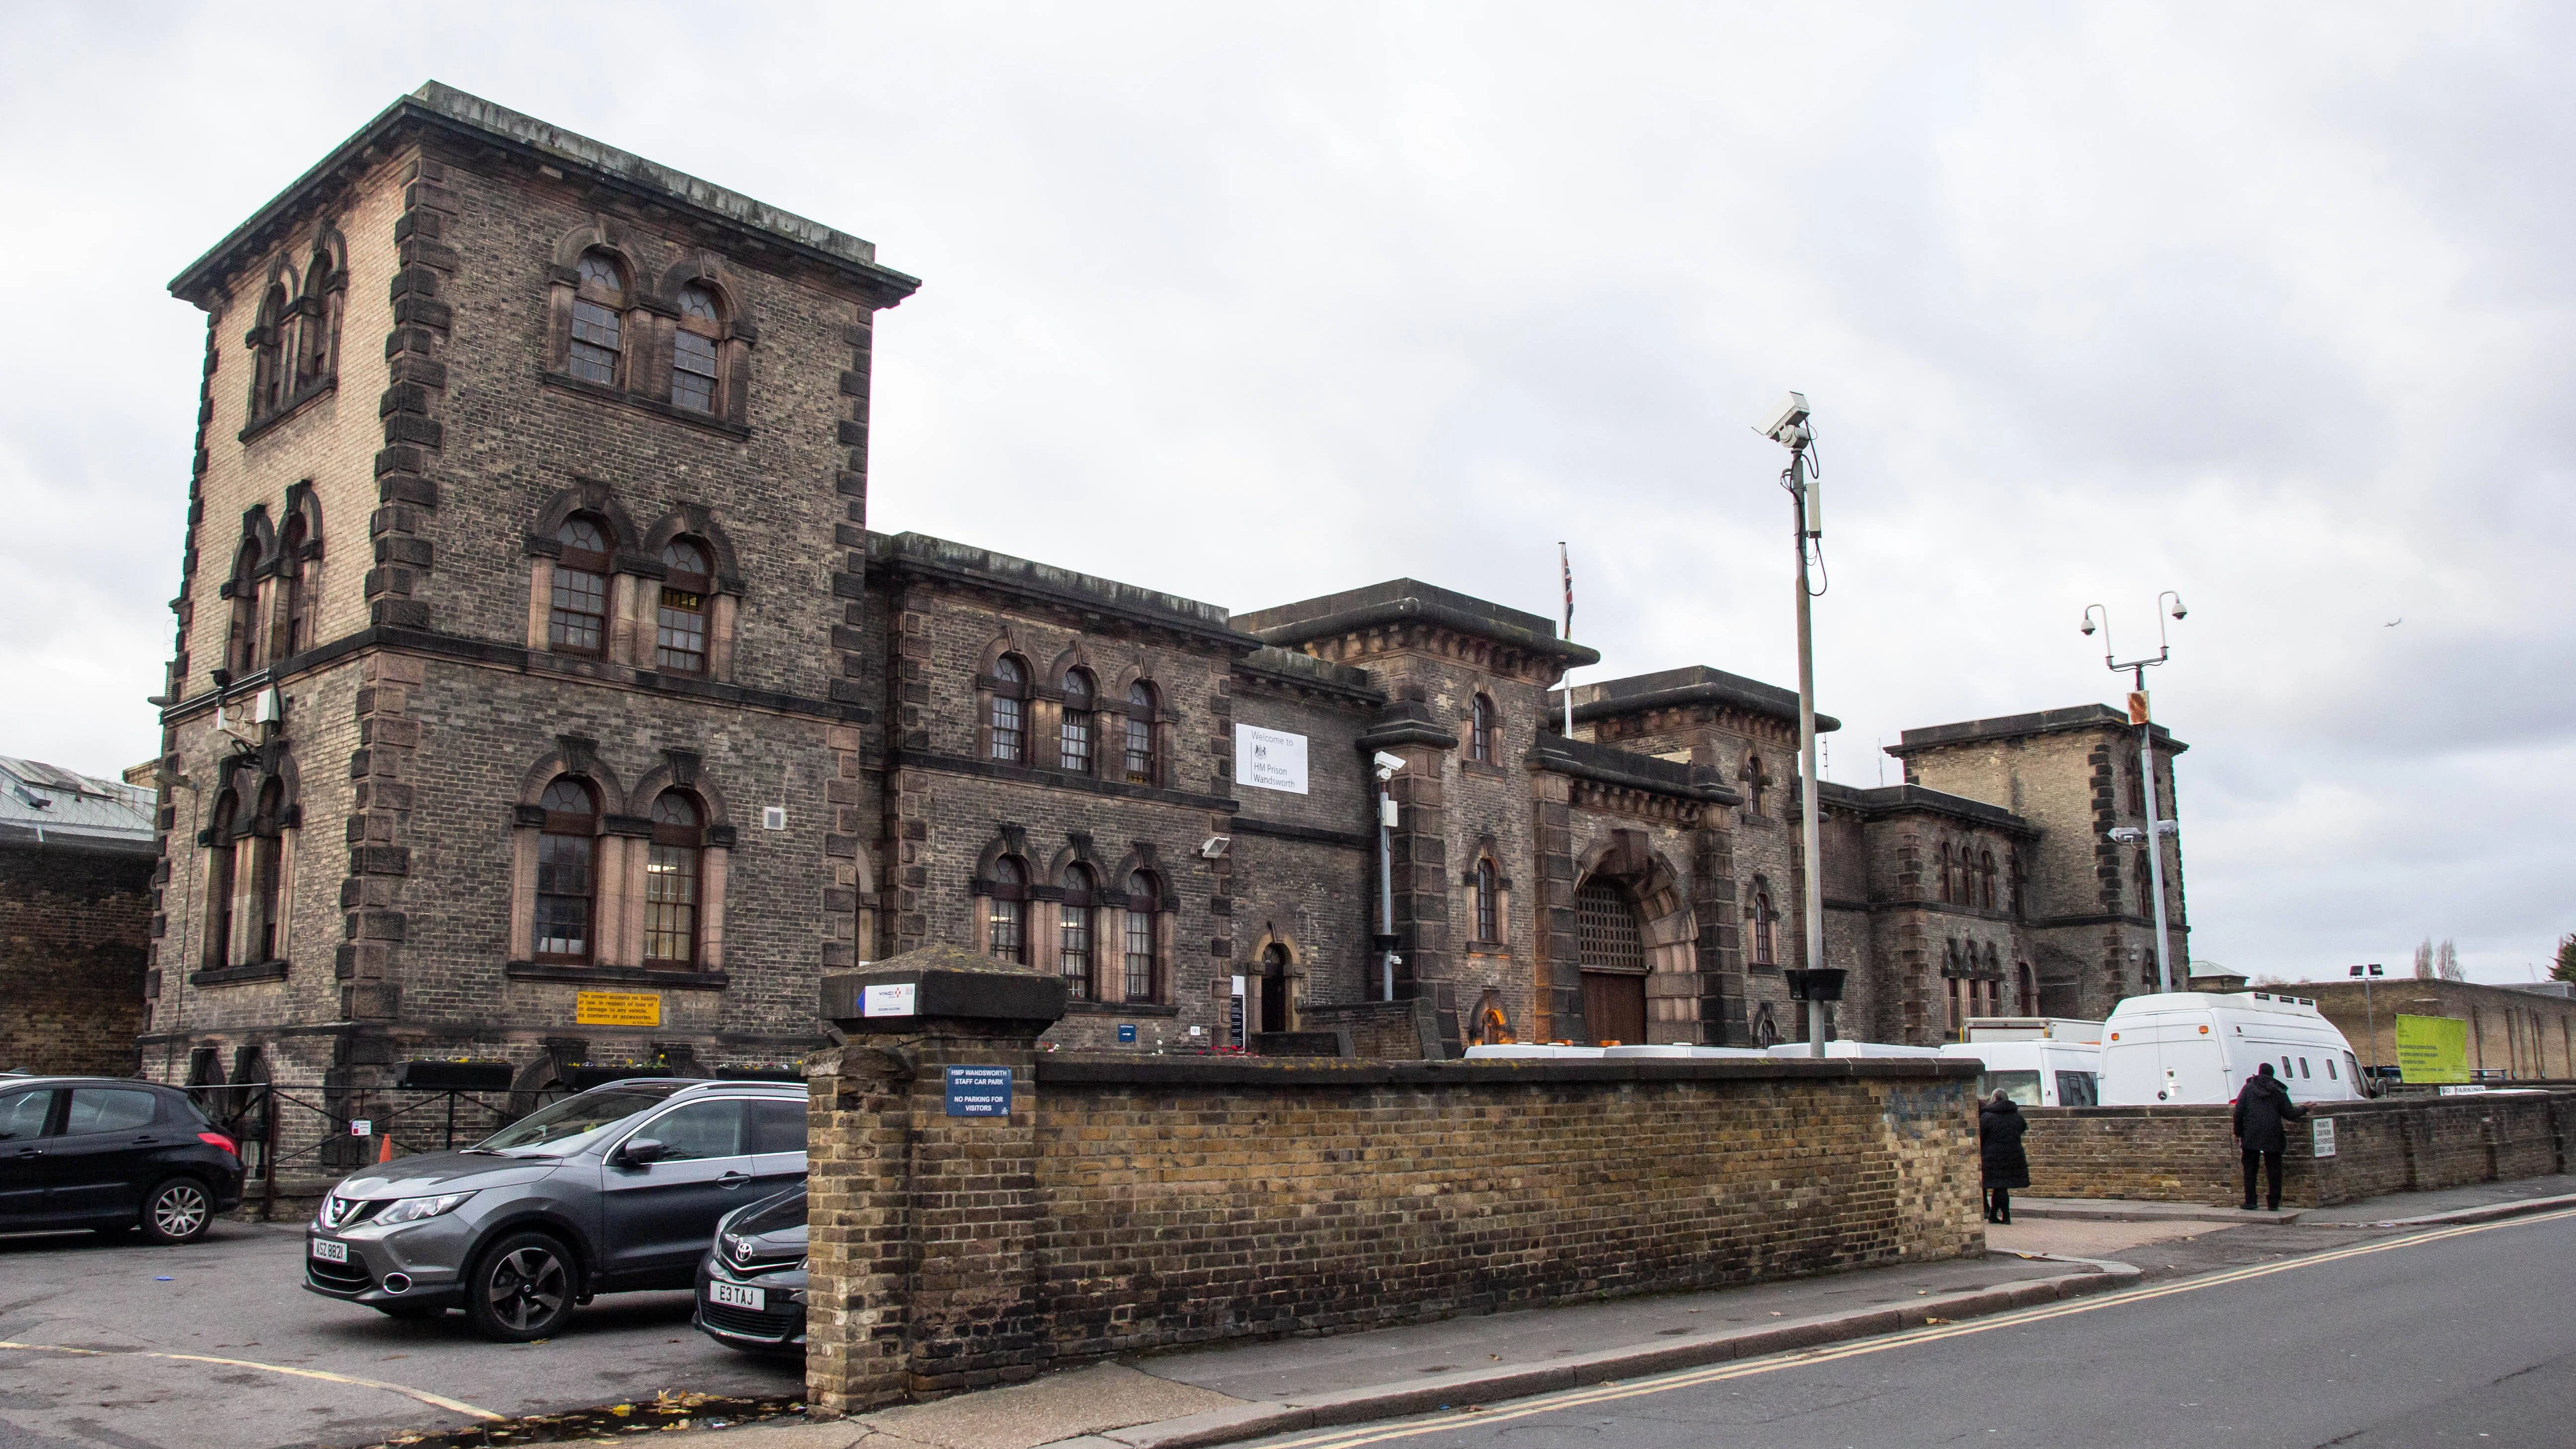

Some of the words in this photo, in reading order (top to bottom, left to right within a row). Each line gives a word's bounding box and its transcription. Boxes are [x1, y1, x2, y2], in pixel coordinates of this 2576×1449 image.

[1251, 730, 1284, 744] Welcome
[1254, 762, 1265, 772] HM
[1268, 764, 1287, 775] Prison
[1254, 774, 1295, 788] Wandsworth
[317, 1241, 326, 1256] ASZ
[328, 1244, 342, 1259] 8821
[720, 1286, 731, 1301] E3
[734, 1288, 753, 1305] TAJ
